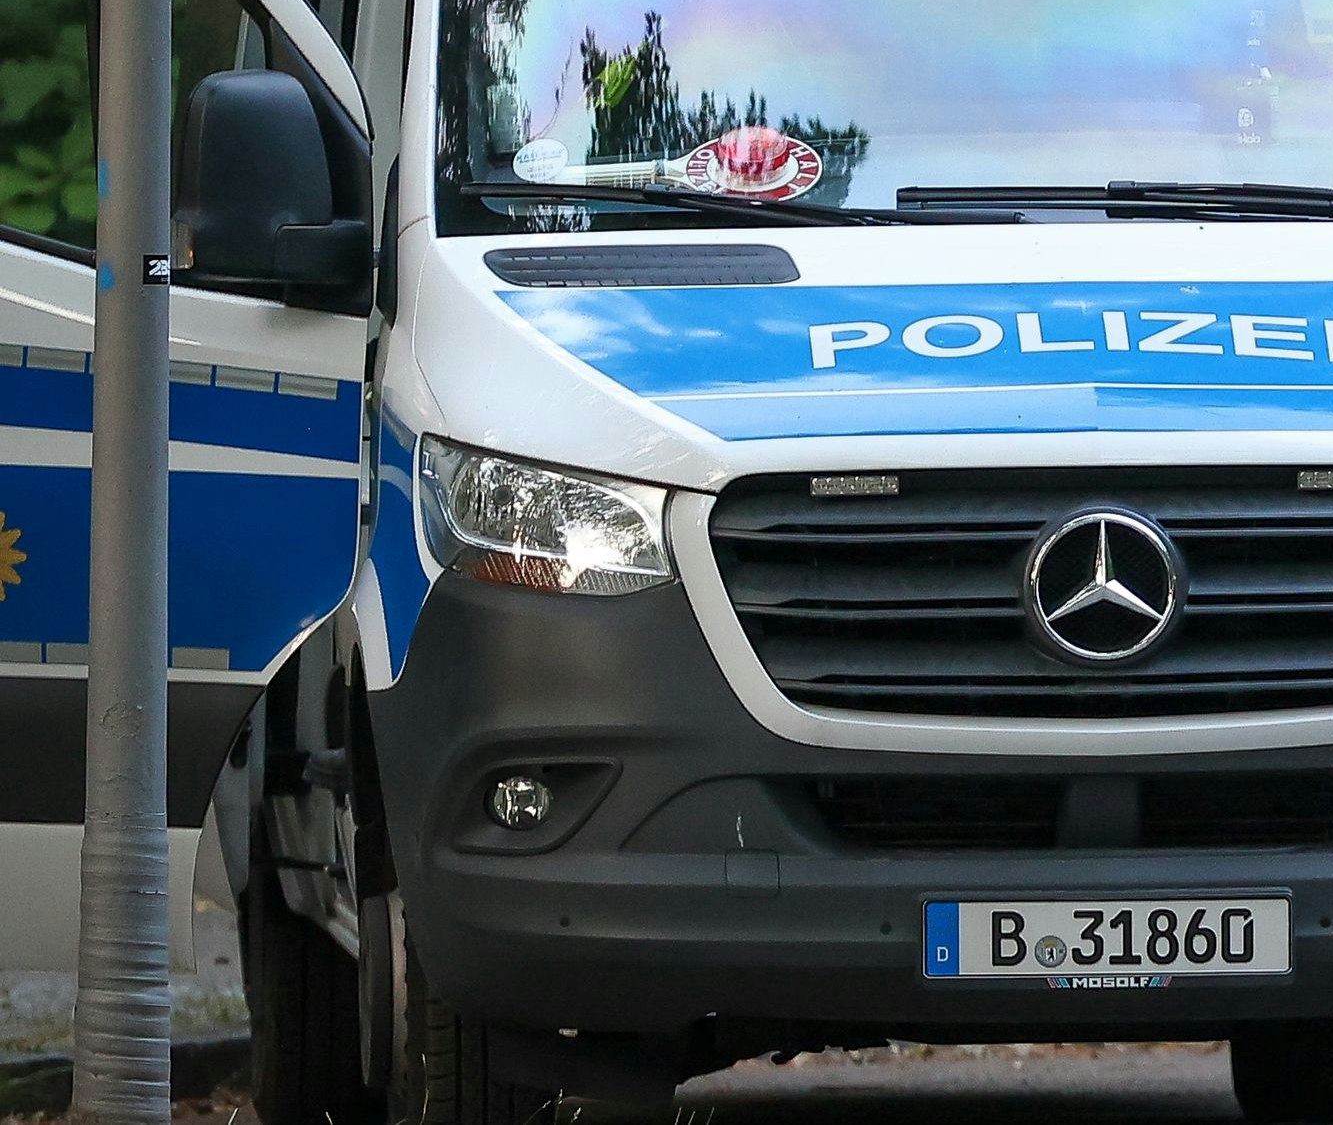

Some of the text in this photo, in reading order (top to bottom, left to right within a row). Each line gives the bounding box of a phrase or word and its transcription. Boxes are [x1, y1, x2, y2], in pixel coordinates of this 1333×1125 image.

[687, 148, 724, 195] OLIZEI
[788, 146, 818, 192] HALT
[937, 908, 1254, 966] D B 31860
[1072, 977, 1150, 988] MOSOLF
